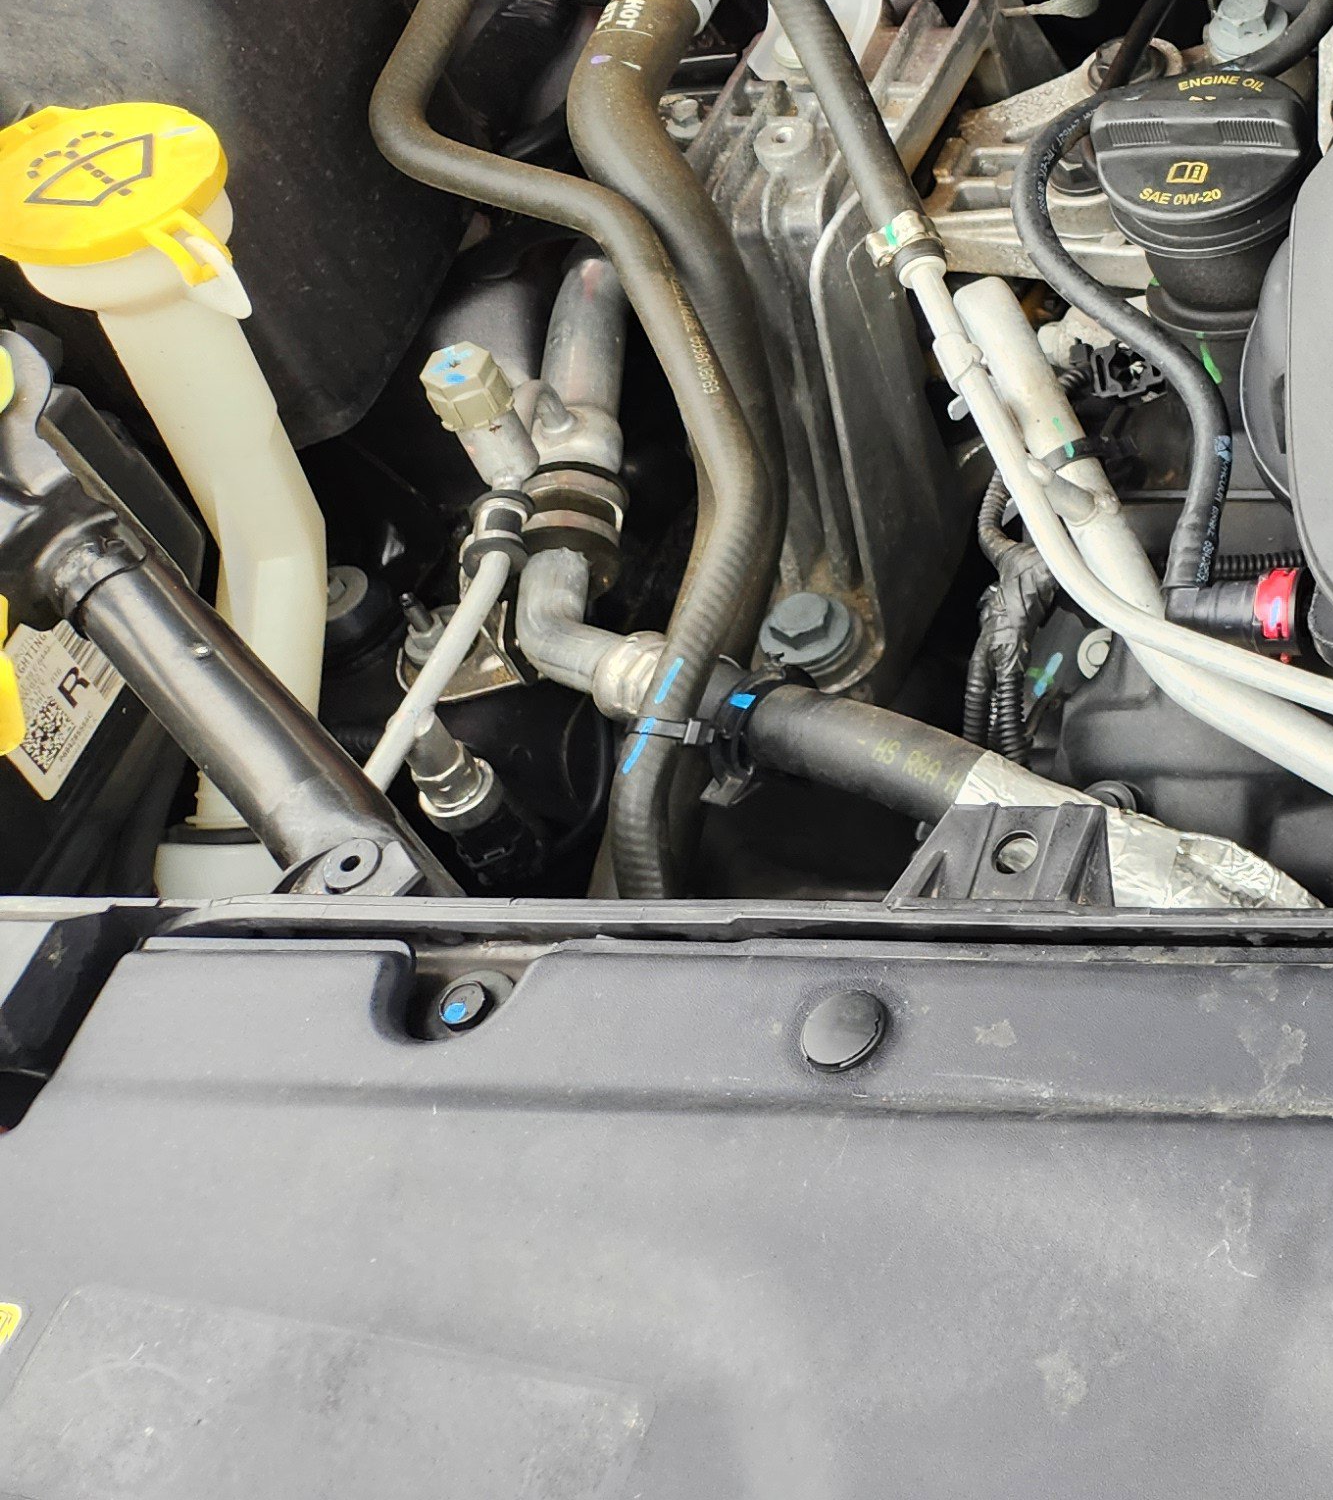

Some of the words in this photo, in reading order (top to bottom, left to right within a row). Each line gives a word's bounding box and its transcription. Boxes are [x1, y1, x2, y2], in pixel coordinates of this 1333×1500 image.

[1177, 74, 1241, 92] ENGINE
[1241, 77, 1266, 93] OIL
[1139, 187, 1173, 205] SAE
[1173, 187, 1223, 206] 0W-20
[57, 666, 91, 709] R
